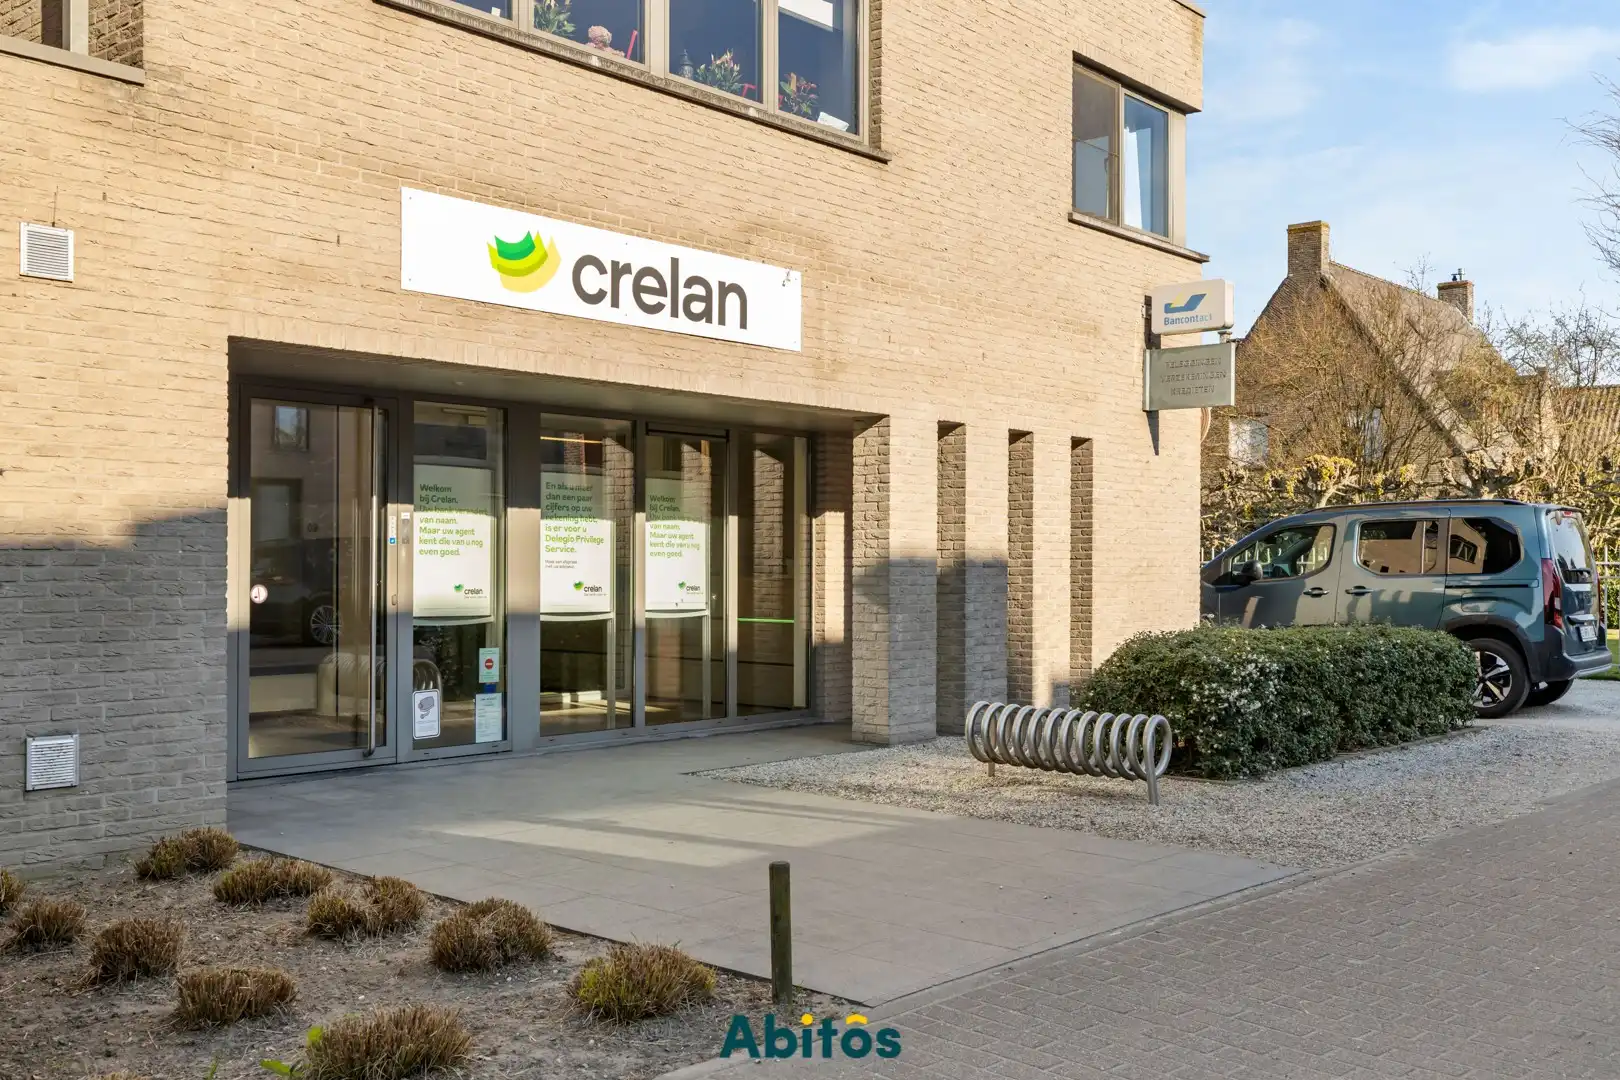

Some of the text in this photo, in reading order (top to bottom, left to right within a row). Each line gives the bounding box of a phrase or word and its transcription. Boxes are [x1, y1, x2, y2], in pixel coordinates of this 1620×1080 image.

[572, 254, 748, 330] crelan
[1163, 313, 1212, 326] Bancontact
[419, 484, 452, 492] Welkom
[546, 482, 556, 490] En
[420, 495, 458, 504] bij Crelan.
[577, 495, 592, 503] paar
[649, 495, 676, 503] Welkom
[546, 503, 569, 512] cijfers
[571, 505, 580, 513] op
[420, 526, 440, 534] Maar
[455, 528, 475, 537] agent
[546, 524, 551, 532] is
[419, 536, 437, 544] kent
[472, 540, 483, 548] nog
[440, 548, 460, 557] goed.
[545, 545, 577, 553] Service.
